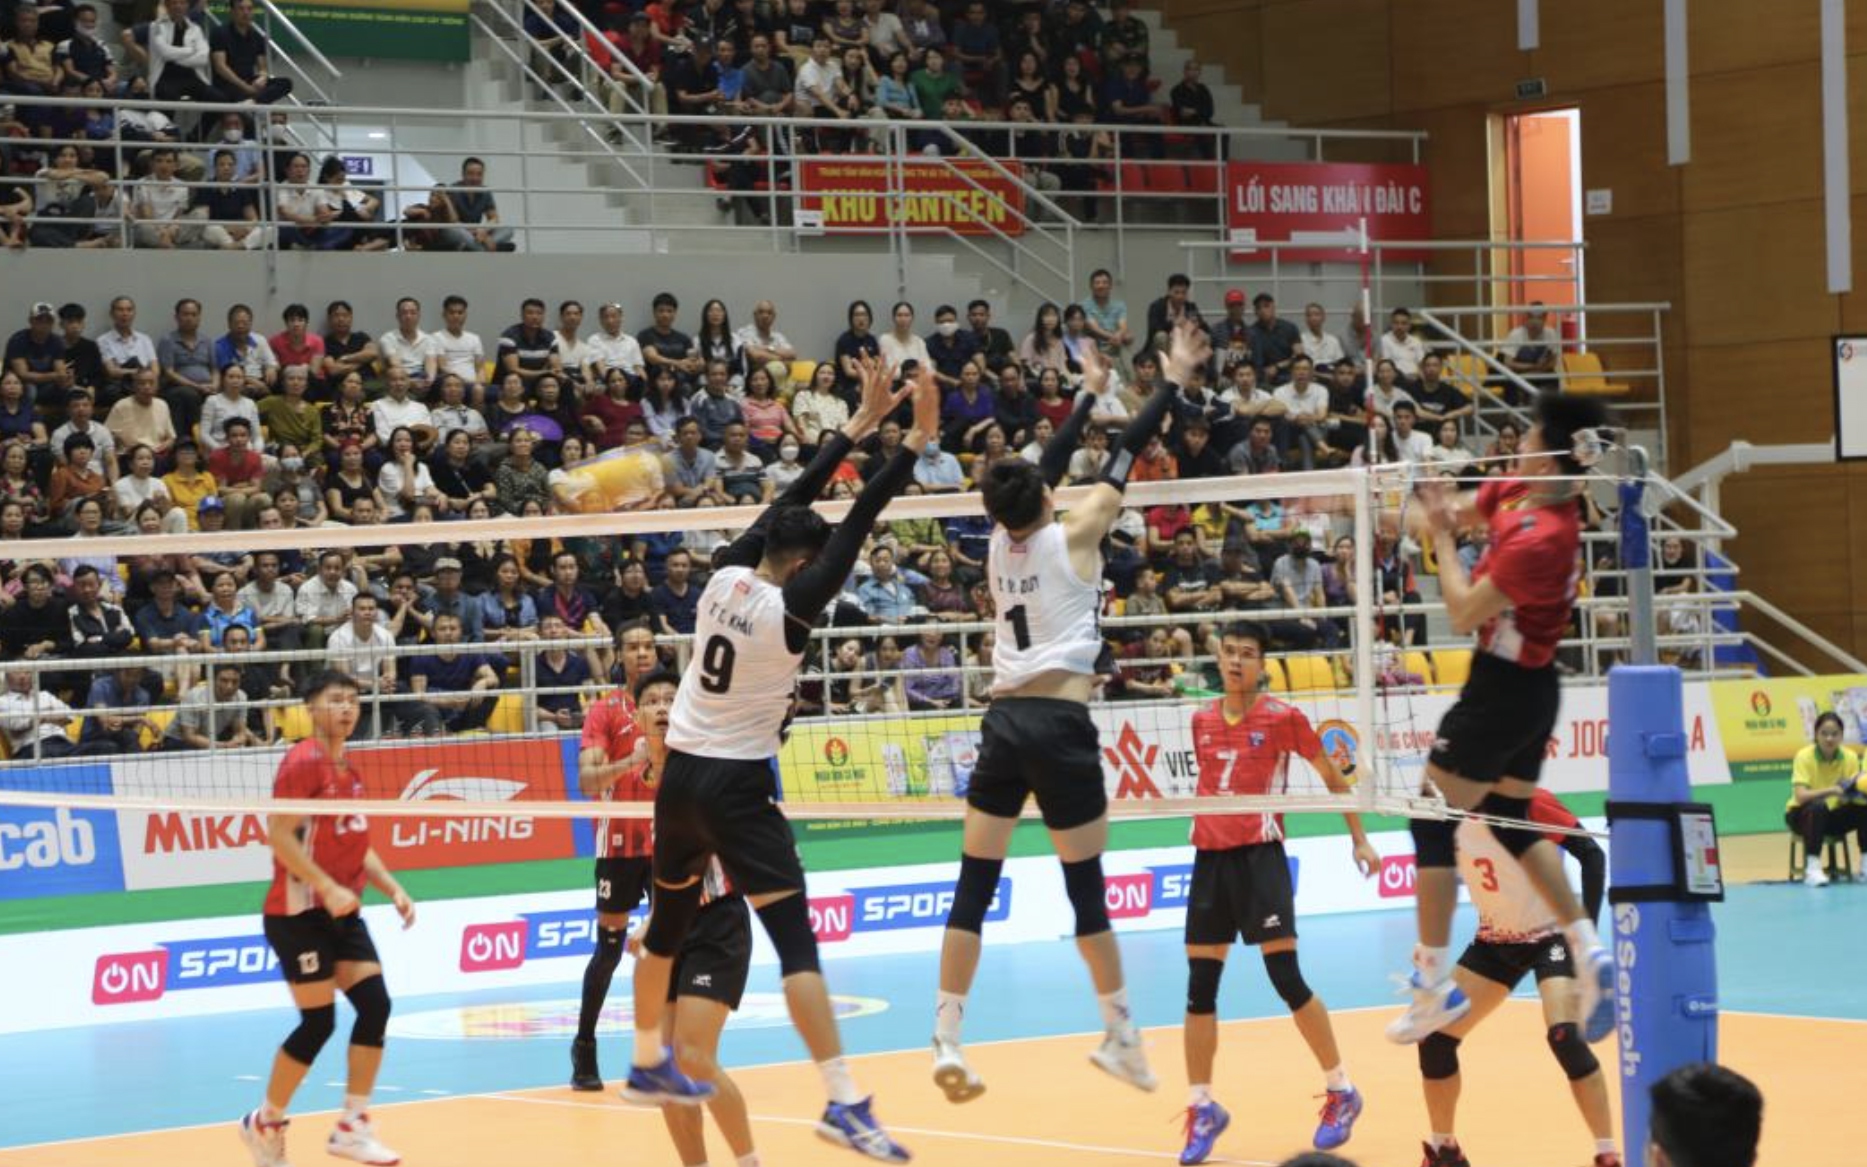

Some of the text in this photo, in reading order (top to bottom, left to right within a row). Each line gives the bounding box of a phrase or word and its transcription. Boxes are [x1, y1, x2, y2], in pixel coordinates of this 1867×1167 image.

[822, 188, 876, 222] KHU
[885, 188, 1005, 222] CANTEEN
[1236, 175, 1265, 213] LỐI
[1270, 185, 1318, 213] SANG
[1376, 180, 1404, 214] ĐÀI
[1409, 187, 1421, 213] C
[1005, 604, 1031, 652] 1
[701, 634, 736, 695] 9
[1216, 750, 1238, 790] 7
[392, 816, 534, 847] LI-NING
[1474, 857, 1499, 892] 3
[1105, 883, 1147, 910] ON
[468, 919, 597, 961] ON SP
[101, 960, 158, 993] ON
[1616, 940, 1641, 1077] Senoh
